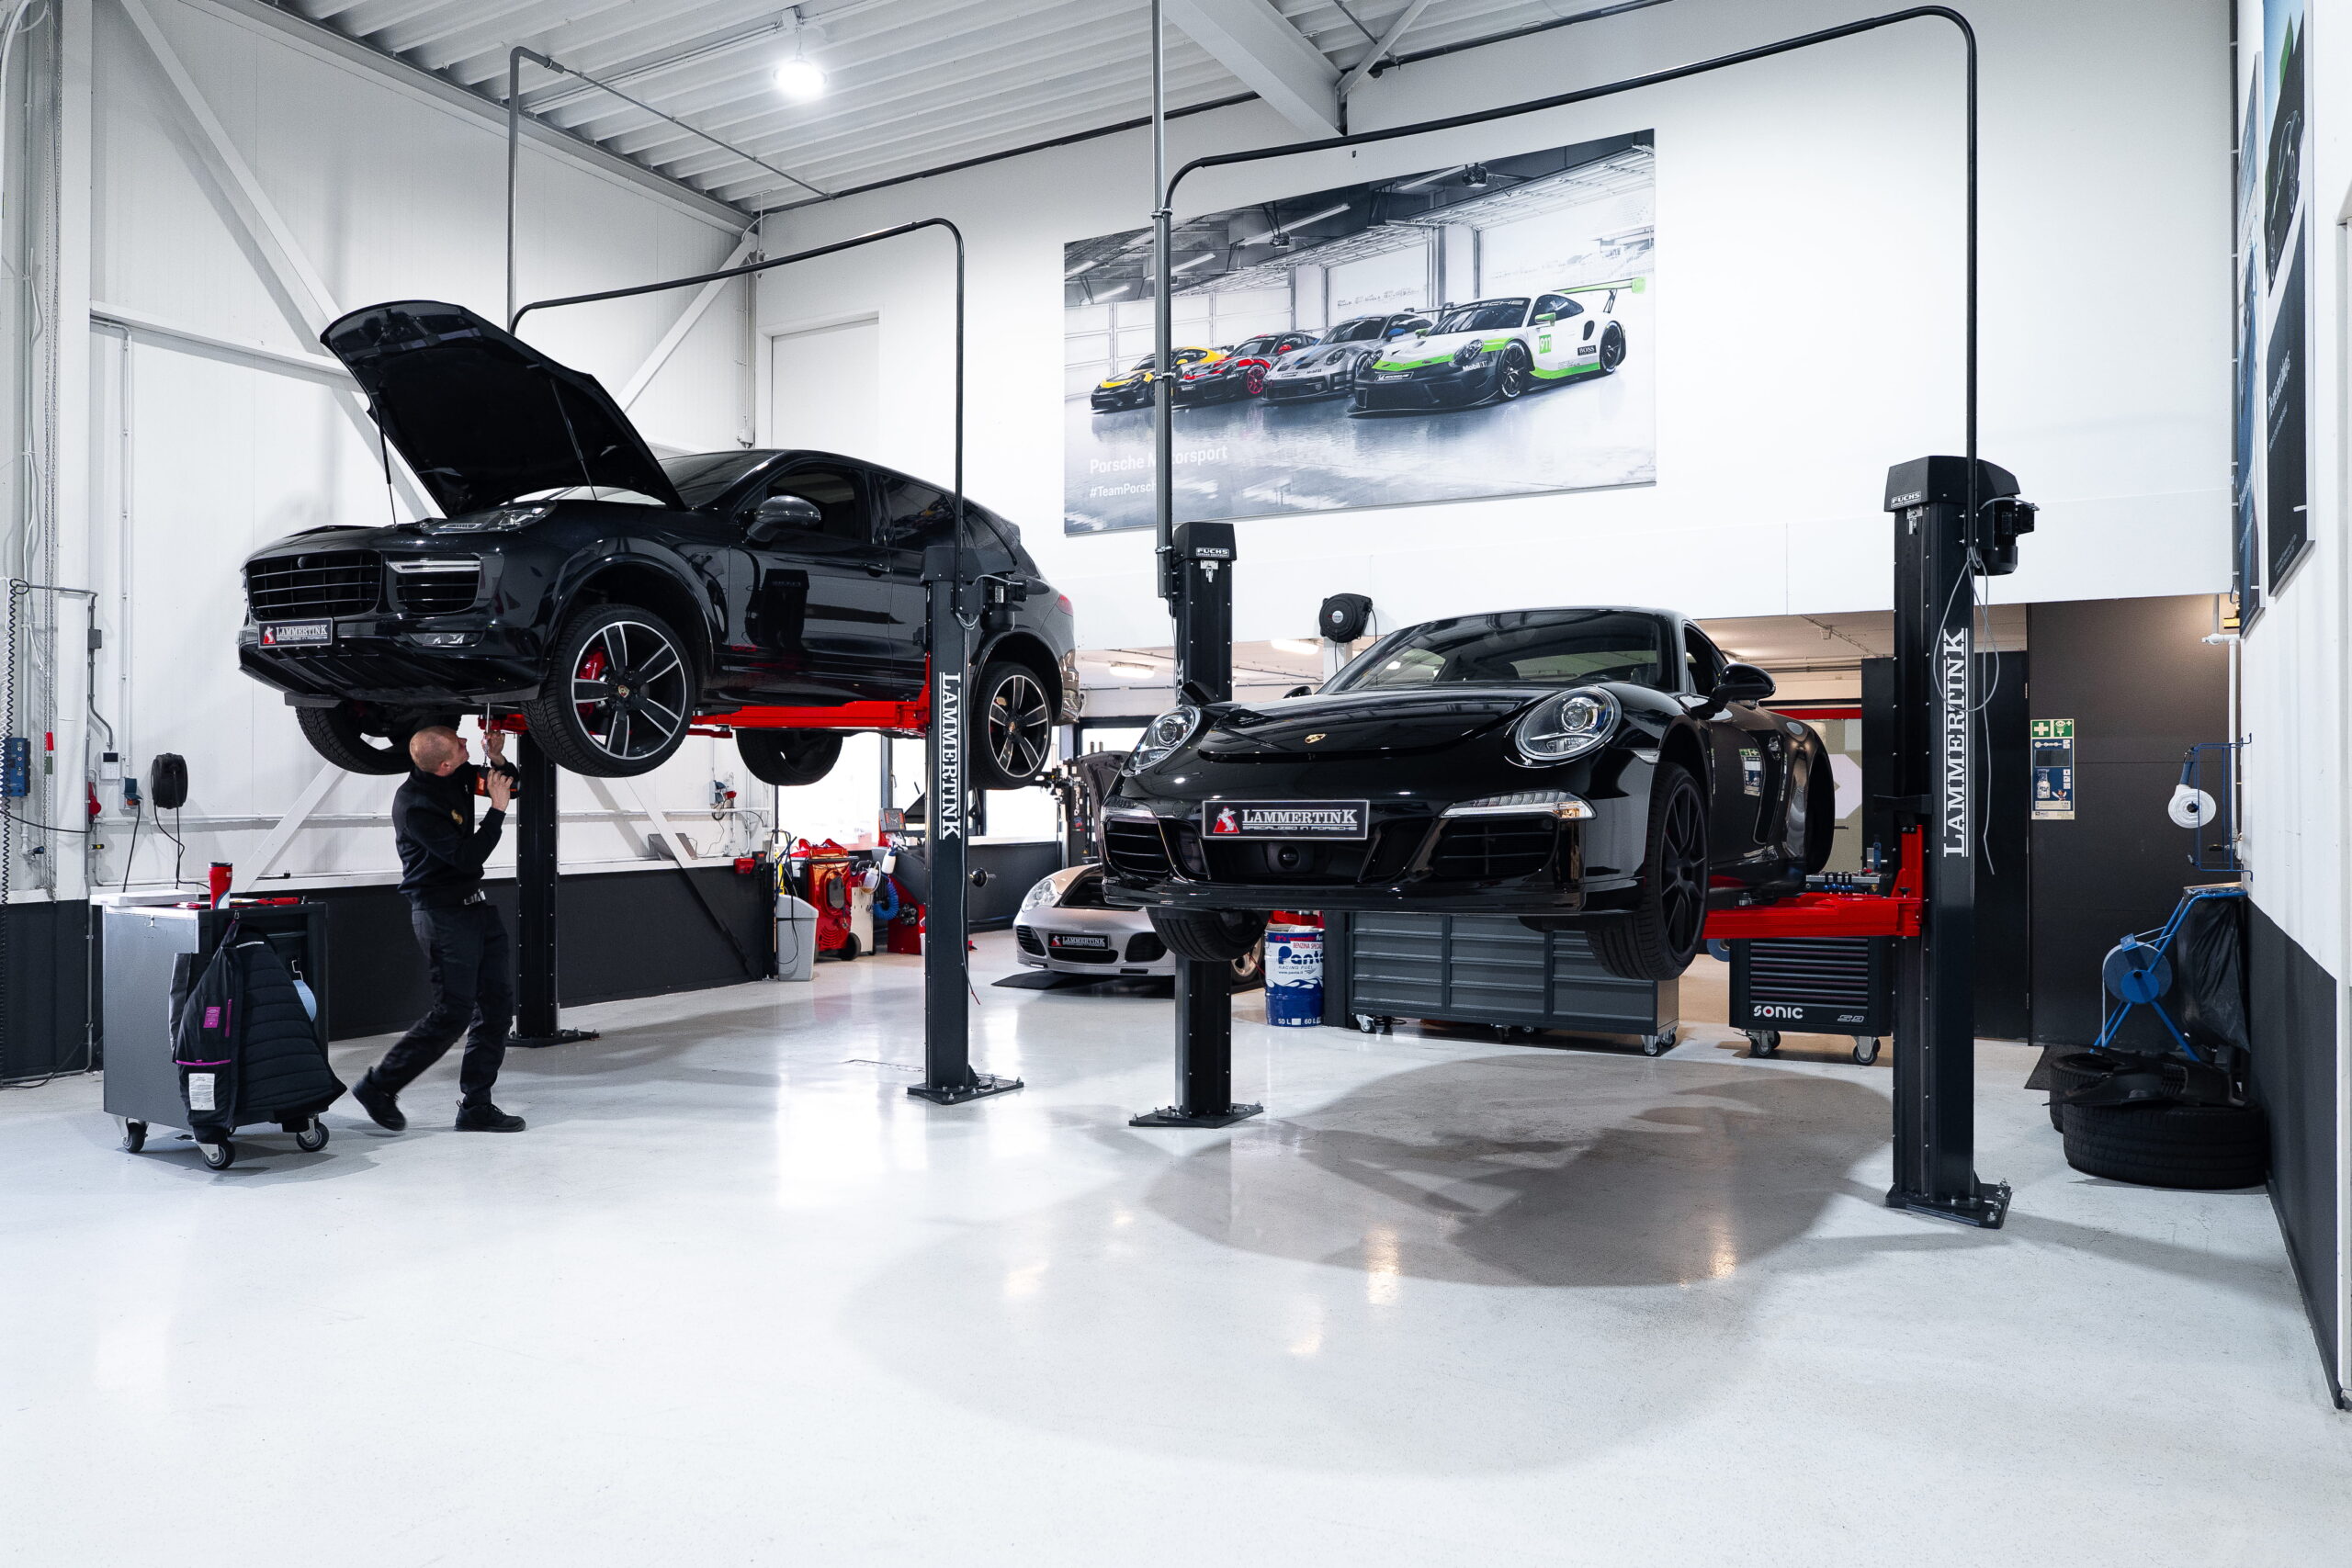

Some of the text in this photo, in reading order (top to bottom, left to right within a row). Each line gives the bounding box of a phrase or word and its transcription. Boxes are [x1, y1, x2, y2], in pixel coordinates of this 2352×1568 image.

[1540, 336, 1551, 351] 911
[1090, 446, 1227, 474] Porsche Mtorsport
[1090, 480, 1157, 498] #TeamPorsch
[1893, 492, 1920, 504] FUCHS
[277, 625, 327, 636] LAMMERTINK
[1943, 627, 1965, 858] LAMMERTINK
[942, 671, 961, 840] LAMMERTINK
[1241, 809, 1358, 824] LAMMERTINK
[1062, 936, 1105, 944] LAMMERTINK
